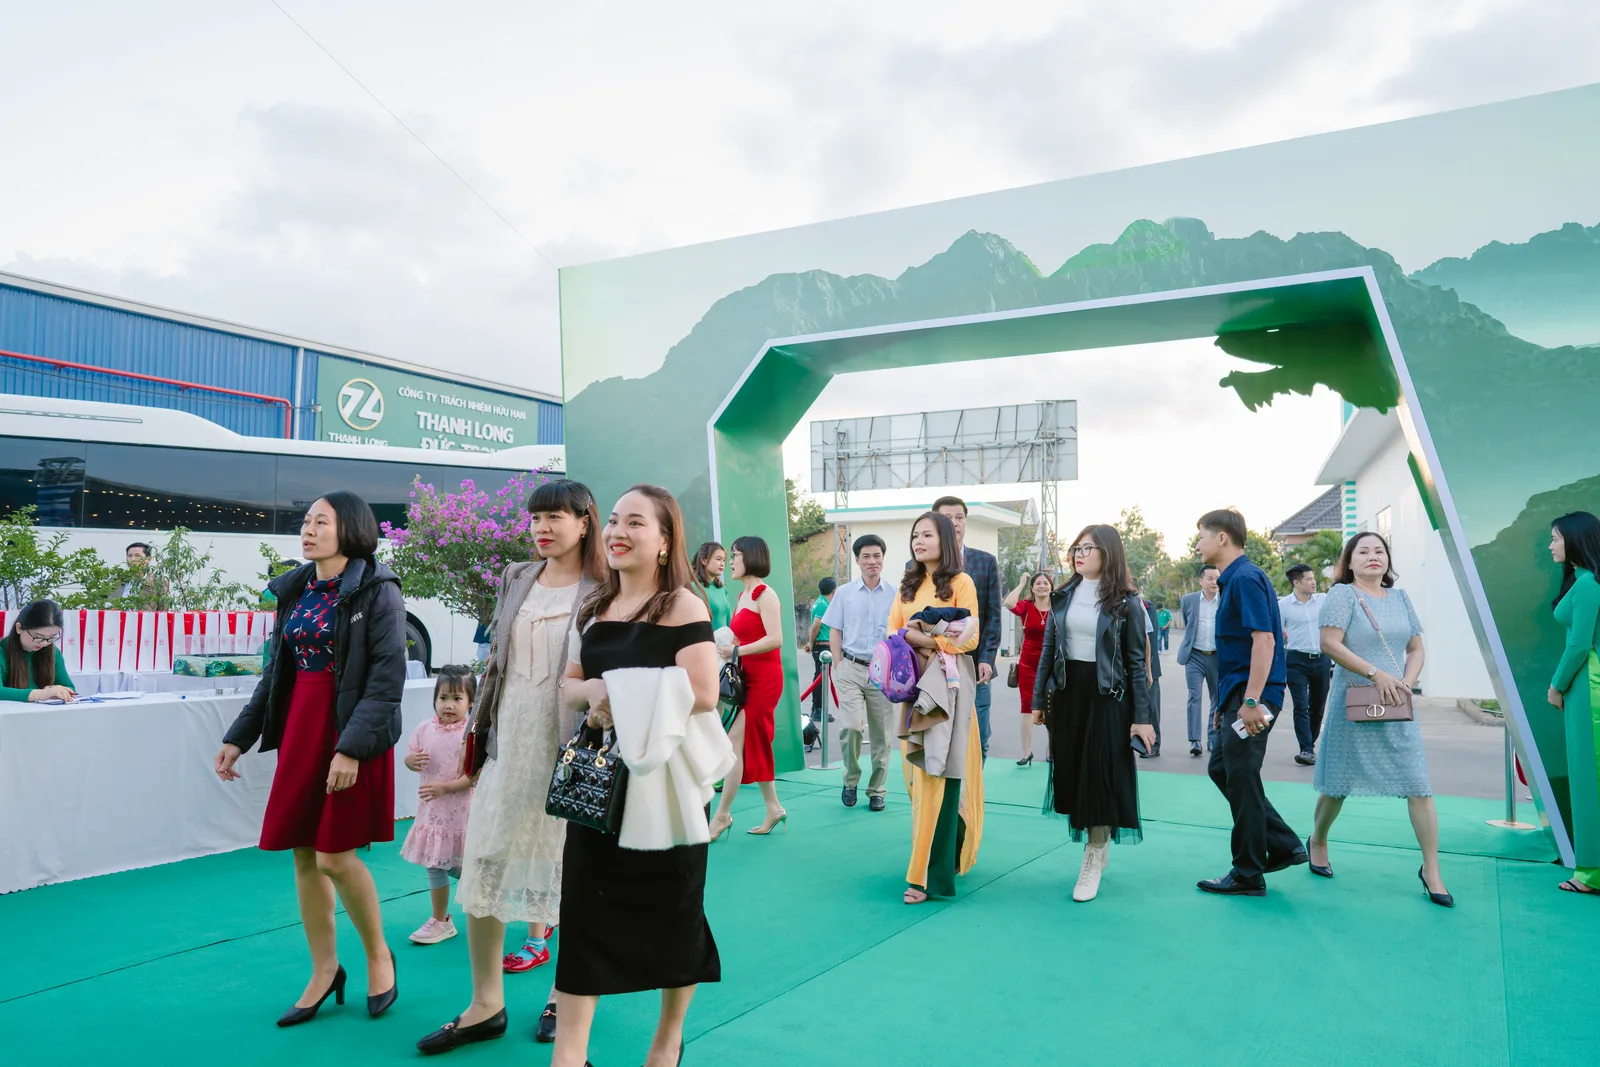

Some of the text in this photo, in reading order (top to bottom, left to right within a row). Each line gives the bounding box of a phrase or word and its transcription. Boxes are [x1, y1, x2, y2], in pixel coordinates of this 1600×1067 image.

[398, 386, 423, 400] CÔNG
[426, 391, 437, 402] TY
[440, 394, 466, 409] TRÁCH
[467, 400, 491, 414] NHIỆM
[510, 409, 526, 421] HẠN
[328, 431, 361, 445] THANH
[416, 411, 514, 443] THANH LONG
